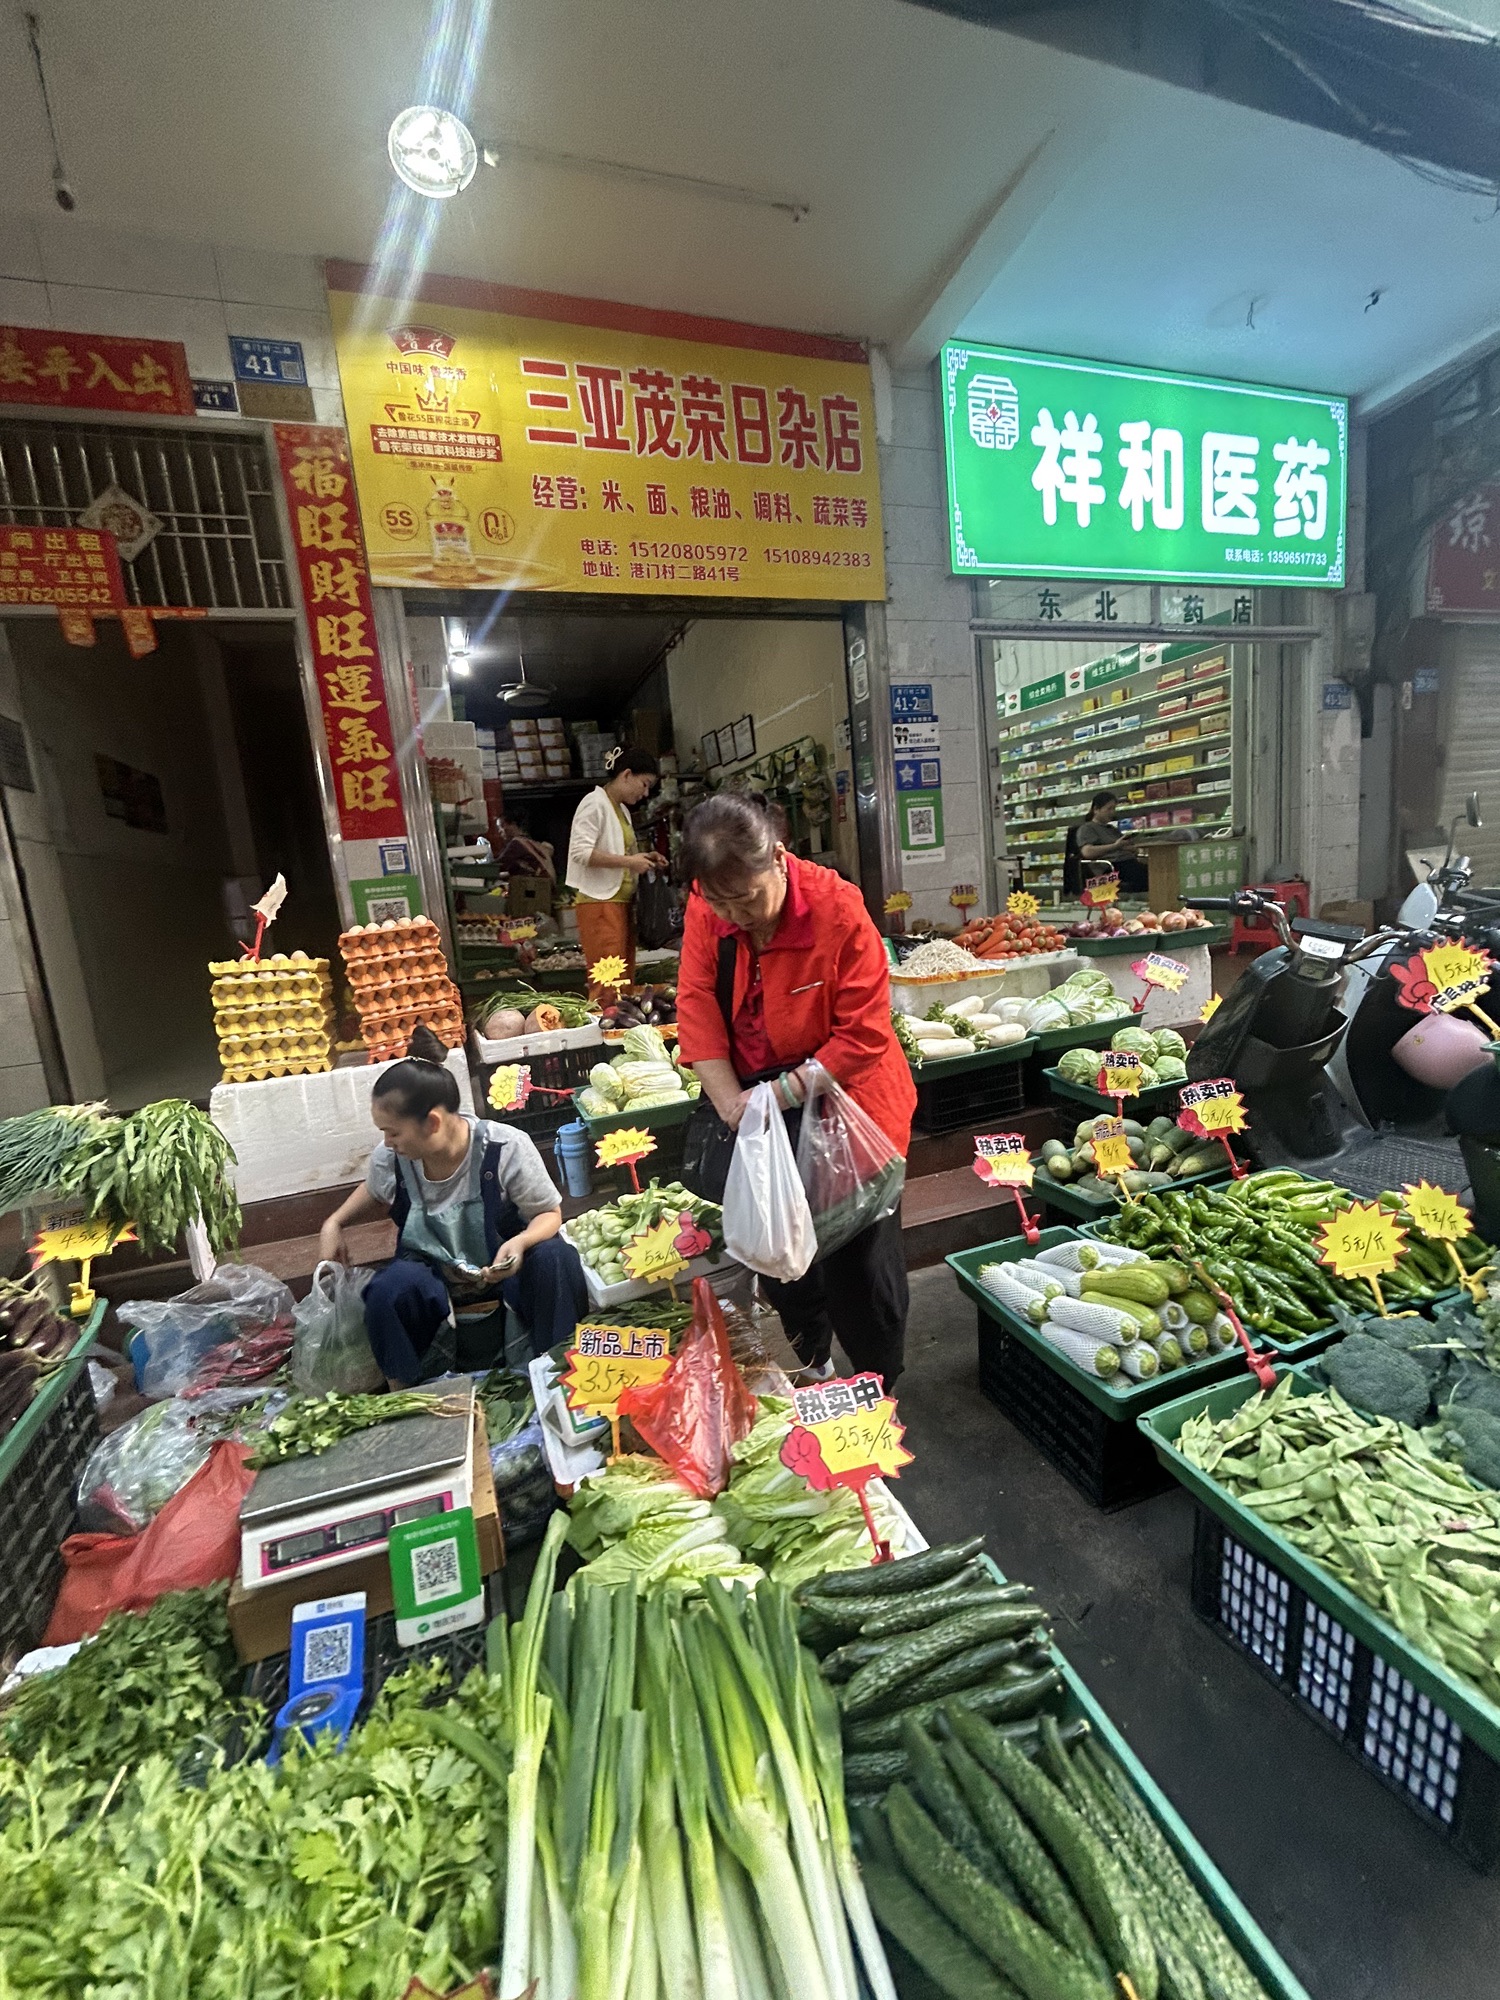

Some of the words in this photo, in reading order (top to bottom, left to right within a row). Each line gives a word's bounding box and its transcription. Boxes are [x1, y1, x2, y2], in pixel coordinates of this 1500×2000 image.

[245, 355, 277, 376] 41
[386, 361, 425, 377] 中国味
[202, 393, 220, 406] 41
[522, 360, 863, 473] 三亚茂荣日杂店
[1030, 407, 1331, 541] 祥和医药
[385, 509, 414, 527] 5S
[763, 548, 871, 568] 15108942383
[1037, 588, 1253, 625] 东北药店
[894, 696, 920, 711] 41-2
[1105, 1054, 1139, 1068] 热卖中
[1182, 1081, 1234, 1105] 热卖中
[1201, 1101, 1233, 1127] 6元/斤
[978, 1136, 1022, 1155] 热卖中
[1420, 1207, 1457, 1231] 4元/斤
[1342, 1231, 1386, 1259] 5元/斤
[580, 1329, 665, 1357] 新品上市
[794, 1378, 881, 1423] 热卖中
[832, 1418, 894, 1458] 3.5元/斤
